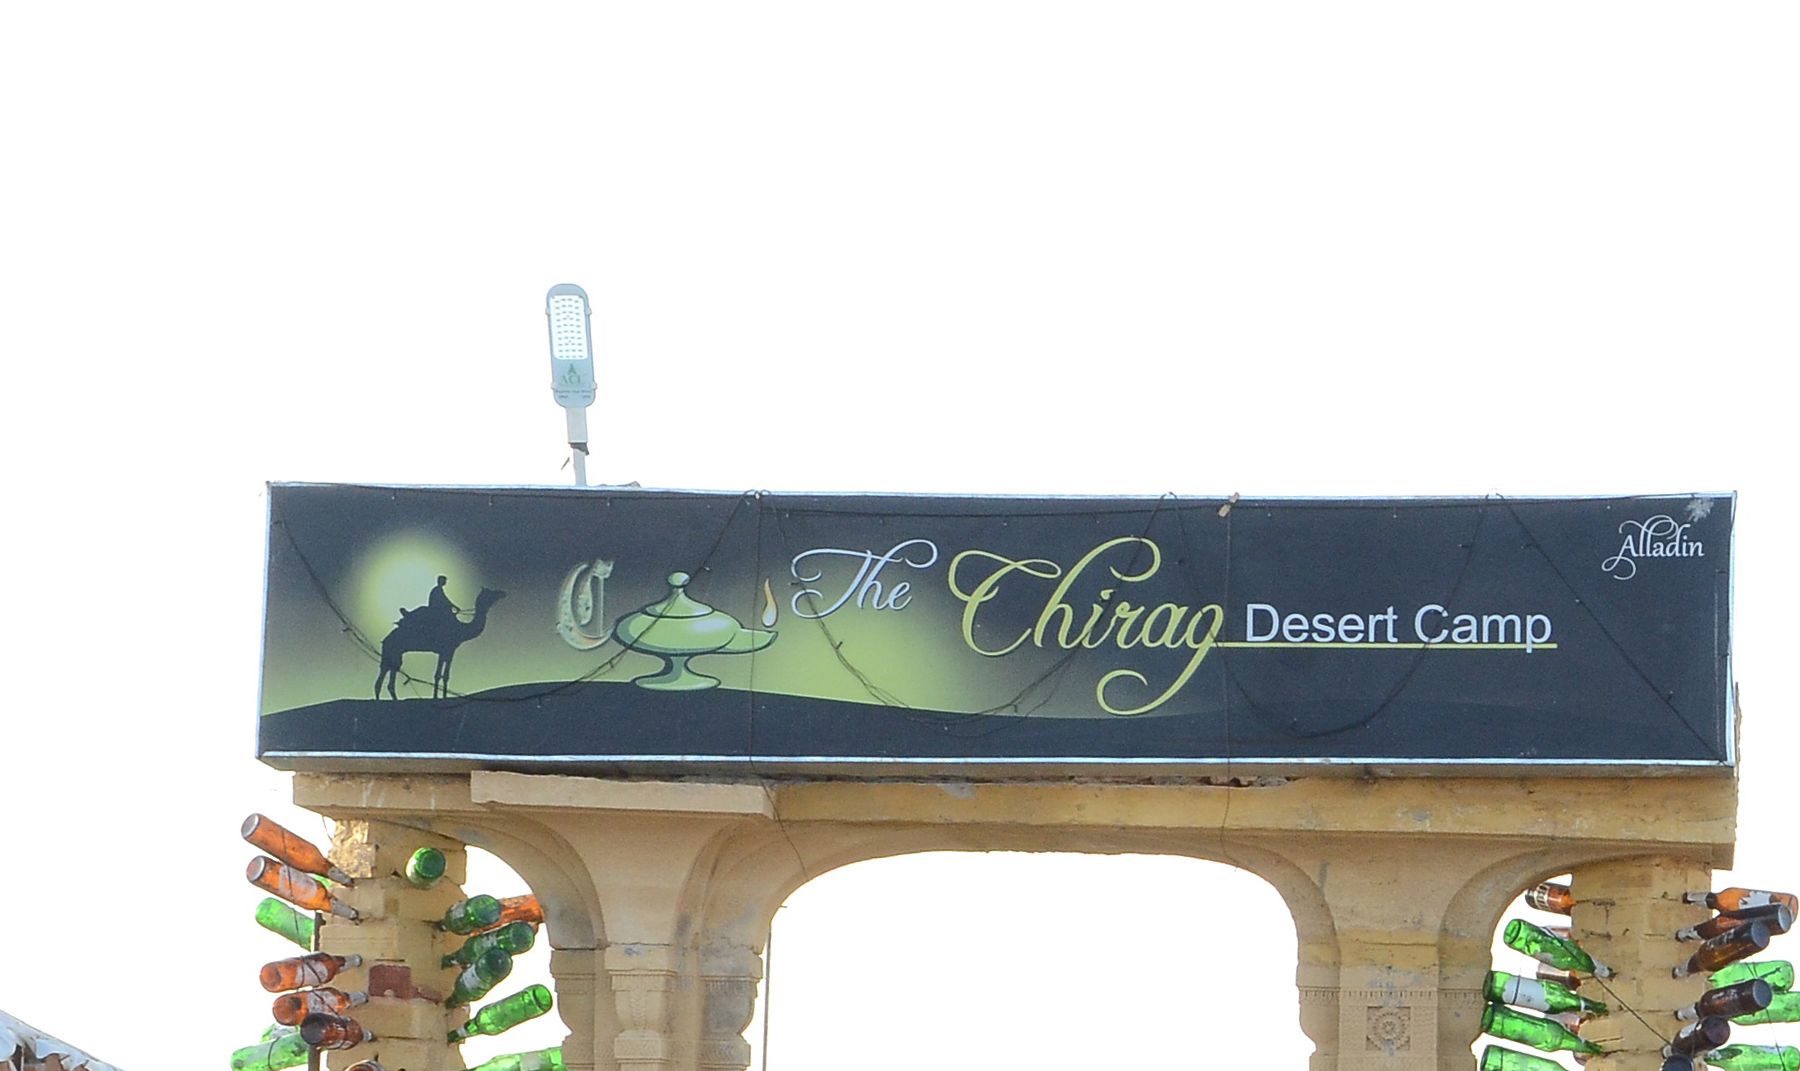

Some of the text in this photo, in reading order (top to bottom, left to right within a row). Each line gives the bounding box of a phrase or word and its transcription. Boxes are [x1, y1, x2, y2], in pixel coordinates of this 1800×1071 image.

[1601, 515, 1704, 580] Alladin
[790, 537, 1553, 717] The Chirag Desert Camp
